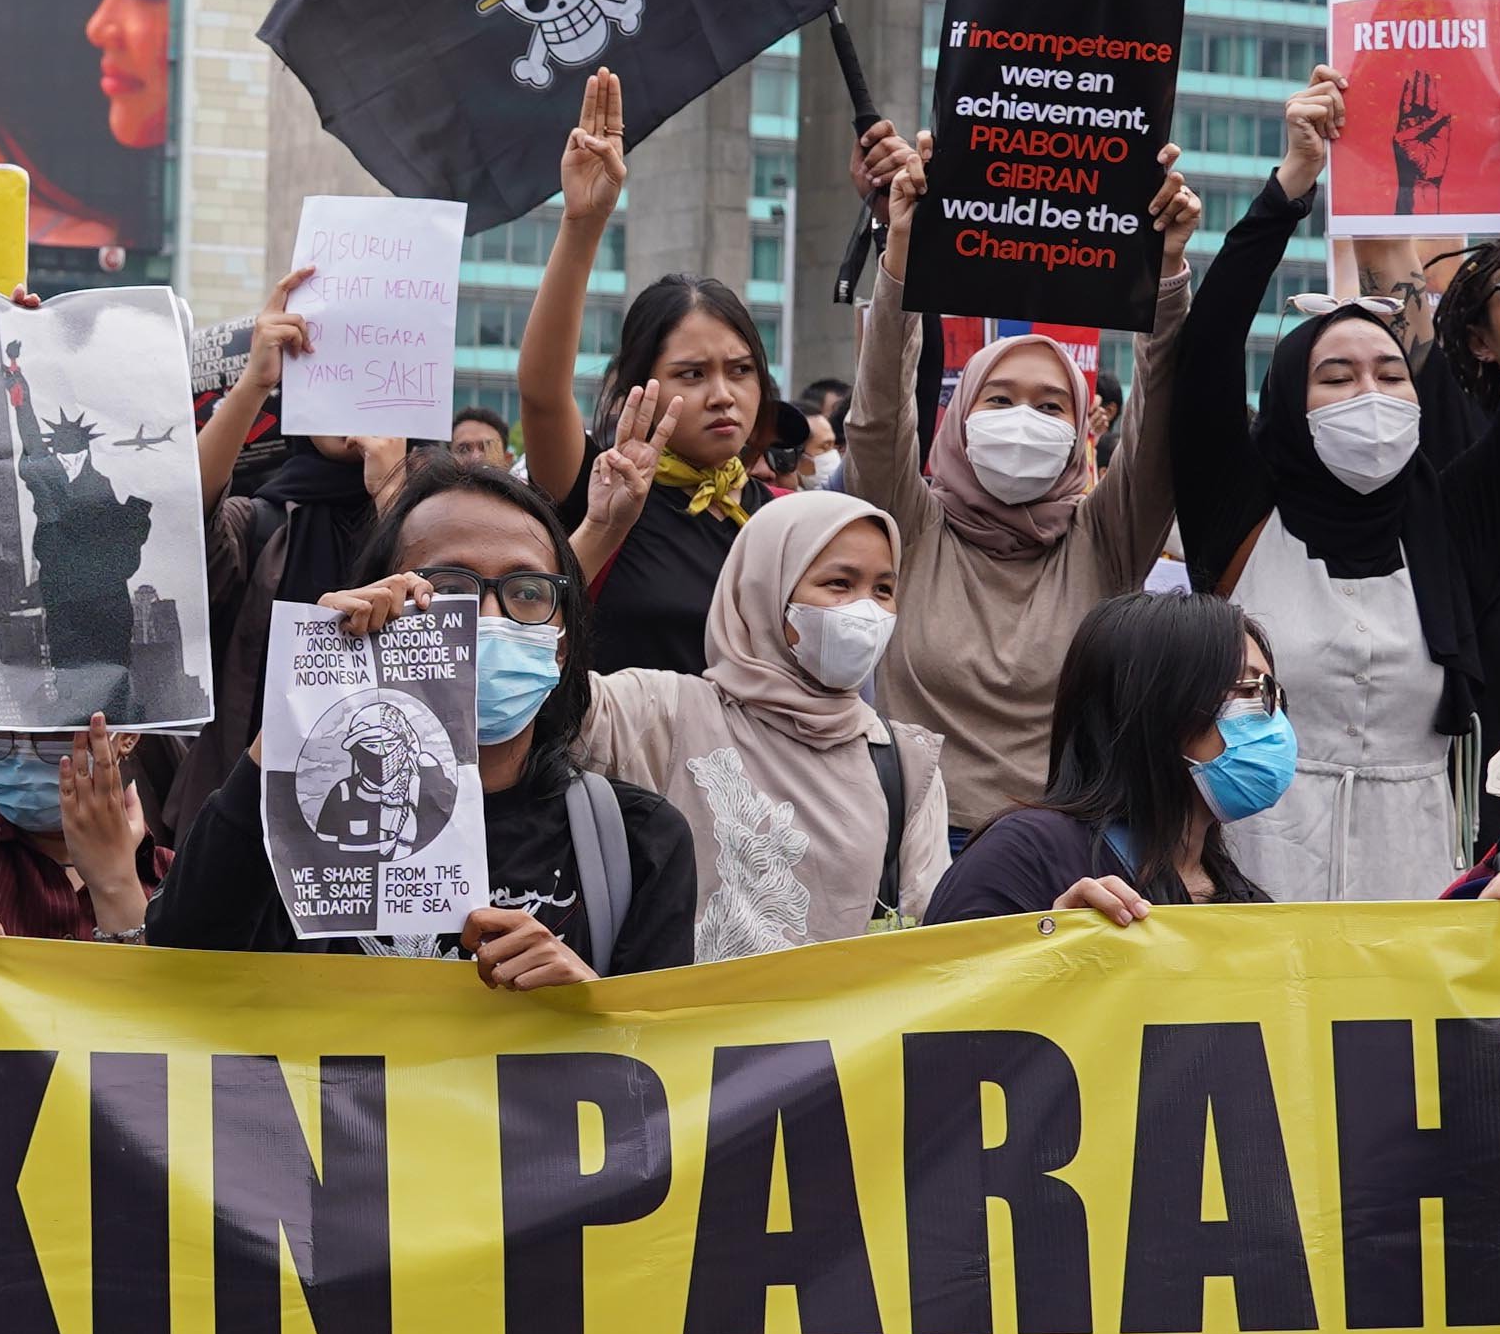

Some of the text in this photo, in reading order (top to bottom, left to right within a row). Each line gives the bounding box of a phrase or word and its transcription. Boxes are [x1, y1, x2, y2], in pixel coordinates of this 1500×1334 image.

[949, 21, 1172, 63] if incompetence
[1354, 19, 1486, 51] REVOLUSI
[1001, 66, 1114, 93] were an
[955, 91, 1150, 134] achievement,
[970, 125, 1129, 163] PRABOWO
[986, 162, 1099, 194] GIBRAN
[941, 197, 1139, 234] would be the
[311, 230, 412, 263] DISURUH
[955, 229, 1116, 271] Champion
[306, 275, 451, 305] SEHAT MENTAL
[345, 323, 426, 347] NEGARA
[305, 364, 353, 388] YANG
[294, 621, 336, 637] THERE'S
[379, 613, 435, 633] HERE'S
[441, 612, 463, 629] AN
[306, 637, 364, 652] ONGOING
[378, 632, 443, 648] ONGOING
[293, 652, 367, 669] ECOCIDE IN
[381, 646, 469, 666] GENOCIDE IN
[295, 670, 371, 686] INDONESIA
[382, 664, 456, 682] PALESTINE
[291, 866, 373, 883] WE SHARE
[386, 865, 462, 881] FROM THE
[294, 883, 373, 900] THE SAME
[385, 881, 469, 897] FOREST TO
[293, 899, 372, 916] SOLIDARITY
[384, 898, 452, 913] THE SEA
